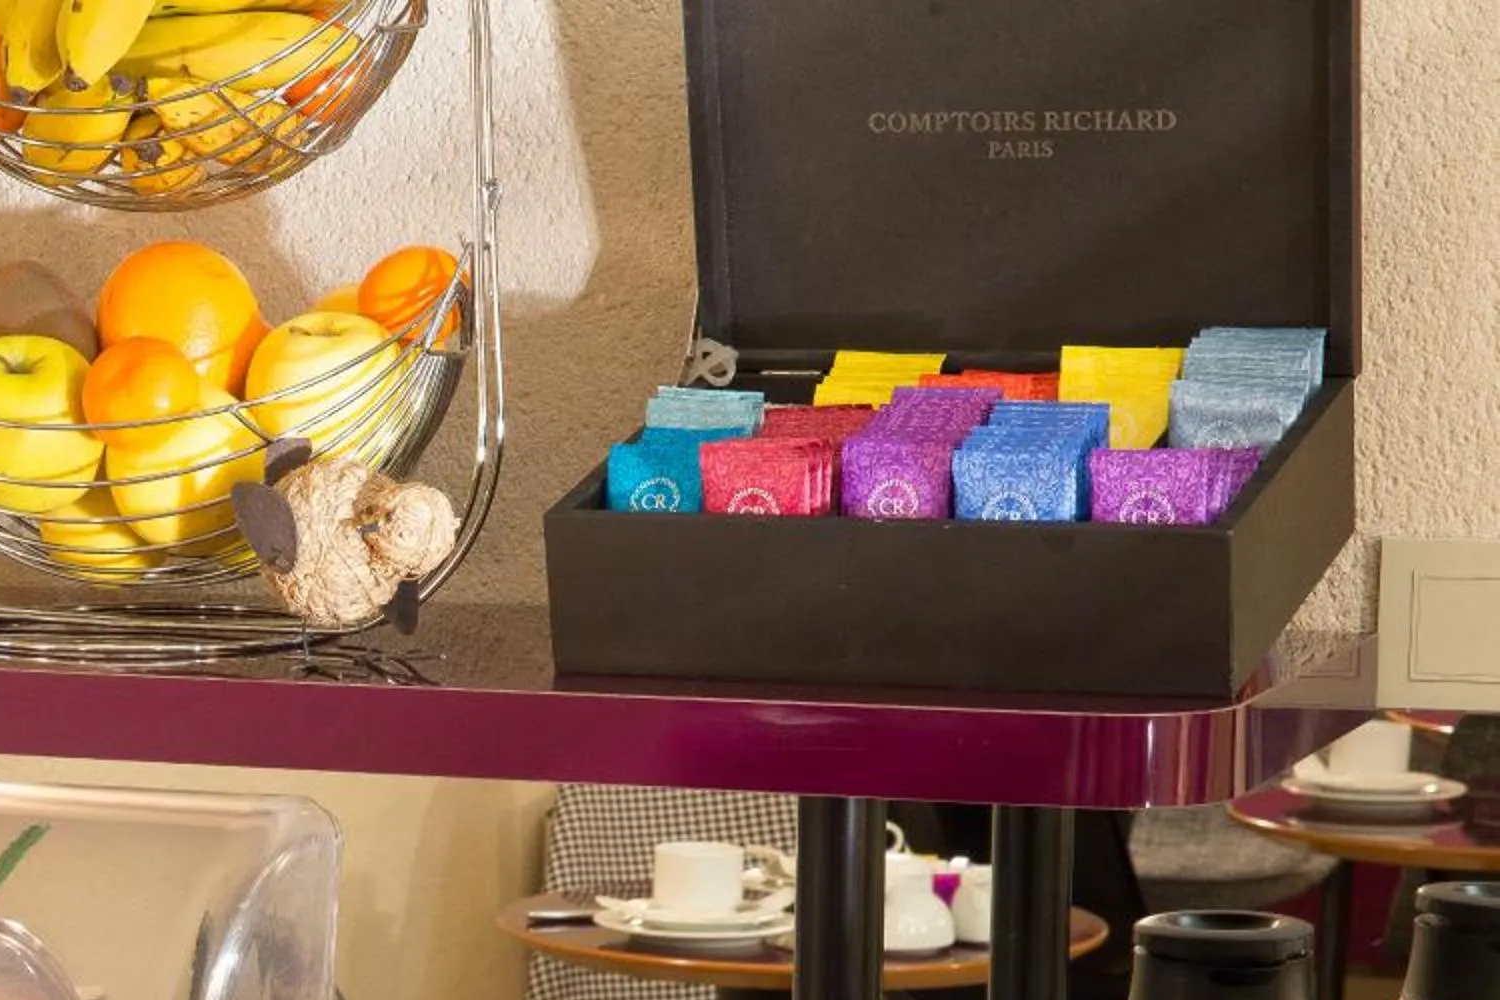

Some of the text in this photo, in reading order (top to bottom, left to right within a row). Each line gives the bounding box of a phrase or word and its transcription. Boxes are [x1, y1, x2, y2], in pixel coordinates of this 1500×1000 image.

[867, 107, 1179, 134] COMPTOIRS RICHARD
[987, 140, 1055, 160] PARIS
[641, 493, 667, 511] CR
[878, 497, 906, 516] CR
